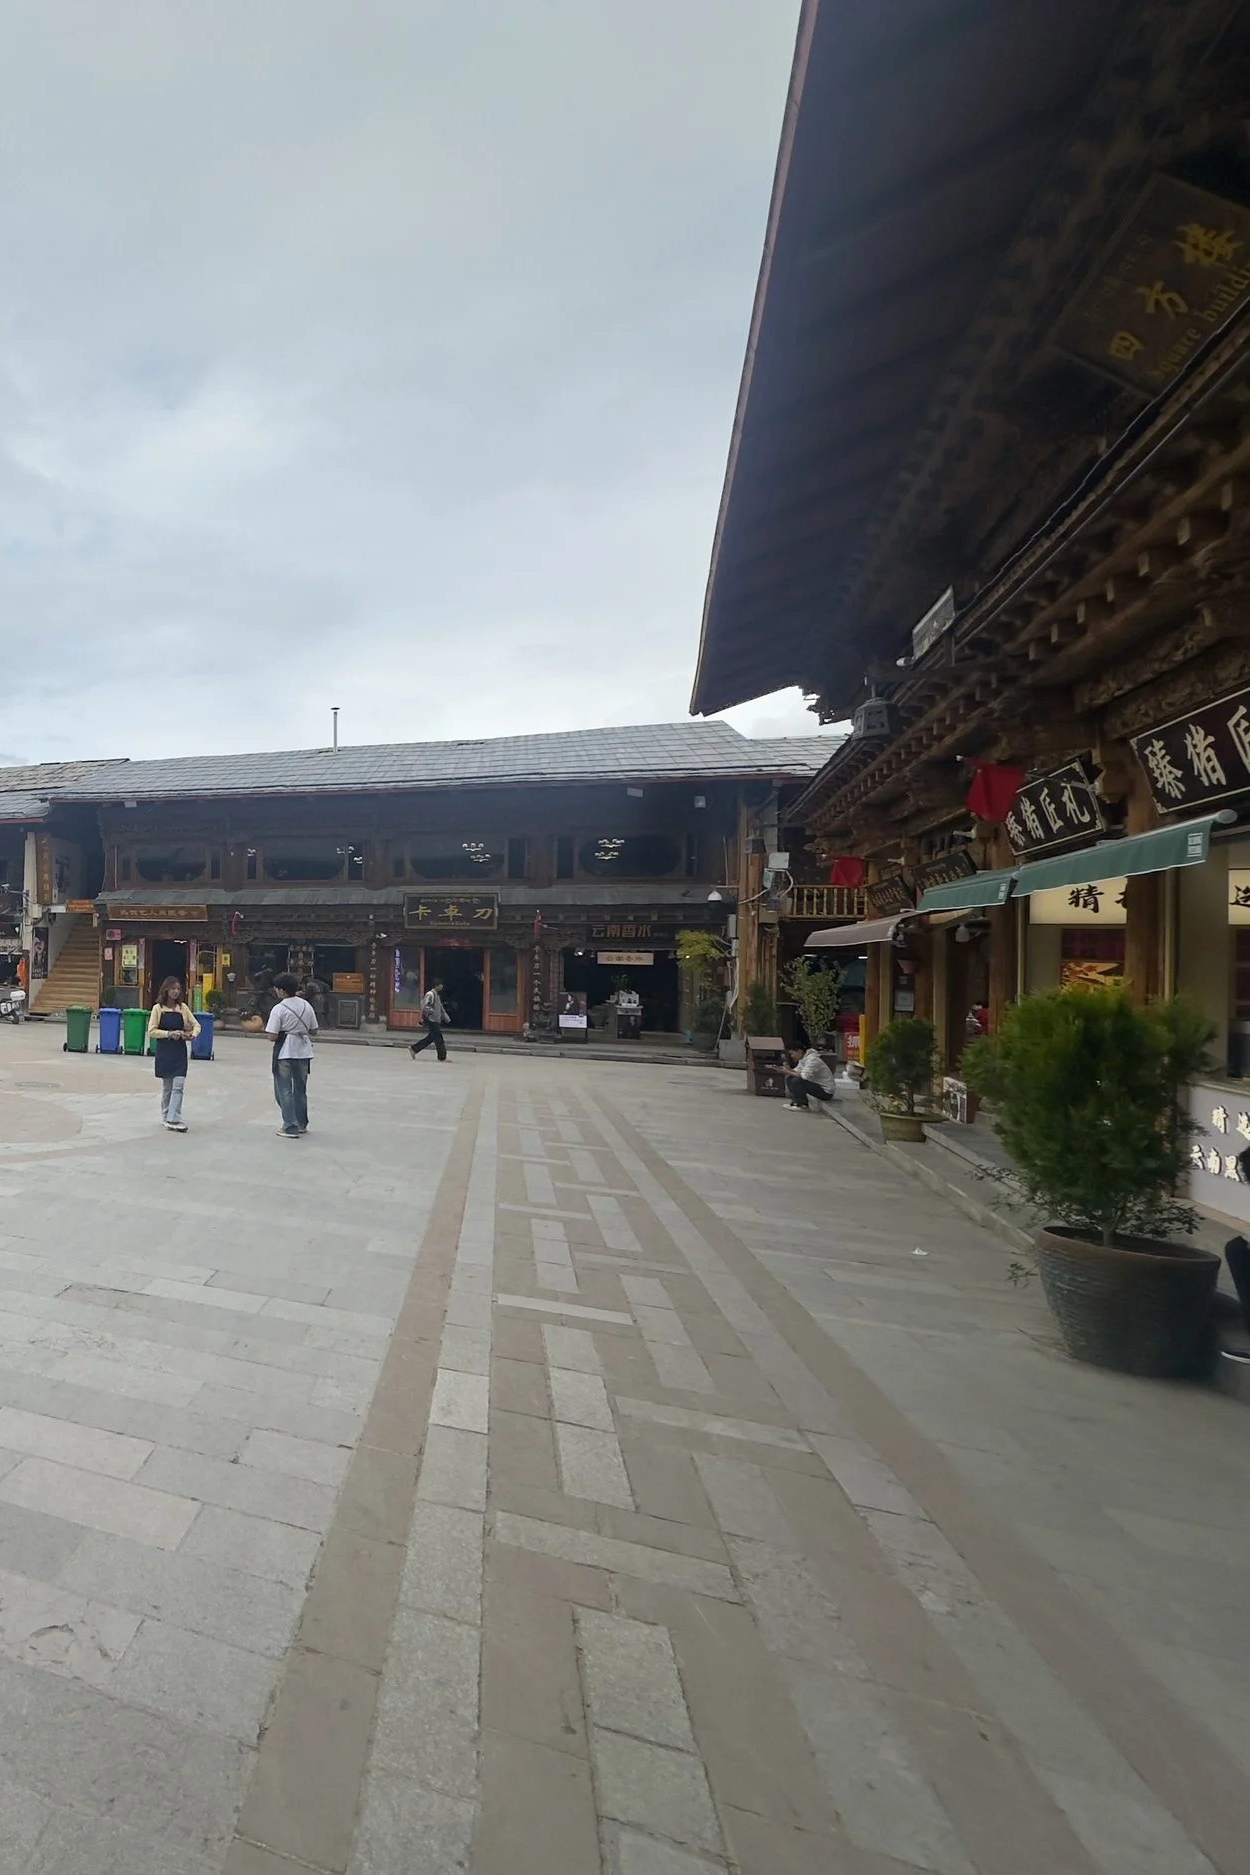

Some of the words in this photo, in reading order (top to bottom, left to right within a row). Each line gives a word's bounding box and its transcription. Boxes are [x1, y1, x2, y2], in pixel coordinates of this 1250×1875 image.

[1193, 262, 1250, 324] buildi
[409, 904, 494, 921] 卡卓刀
[592, 924, 653, 938] 云南香水
